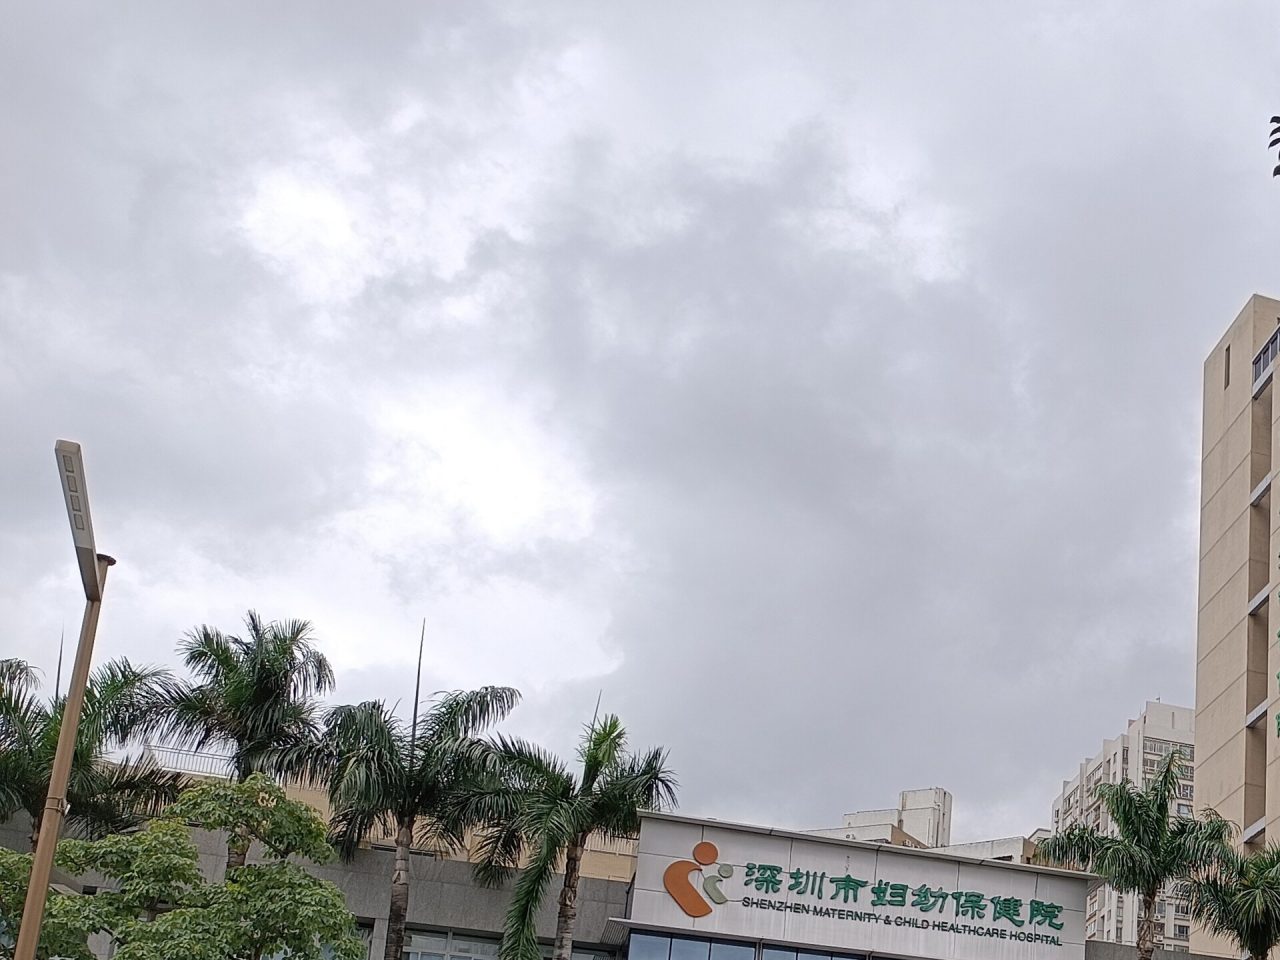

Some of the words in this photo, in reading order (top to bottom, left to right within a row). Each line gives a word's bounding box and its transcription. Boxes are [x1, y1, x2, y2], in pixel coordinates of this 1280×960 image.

[742, 896, 810, 915] SHENZHEN
[813, 905, 882, 924] MATERNITY
[883, 915, 892, 925] &
[894, 916, 930, 930] CHILD
[932, 920, 1007, 939] HEALTHCARE
[1009, 931, 1063, 947] HOSPITAL
[744, 862, 1065, 931] 深圳市妇幼保健院
